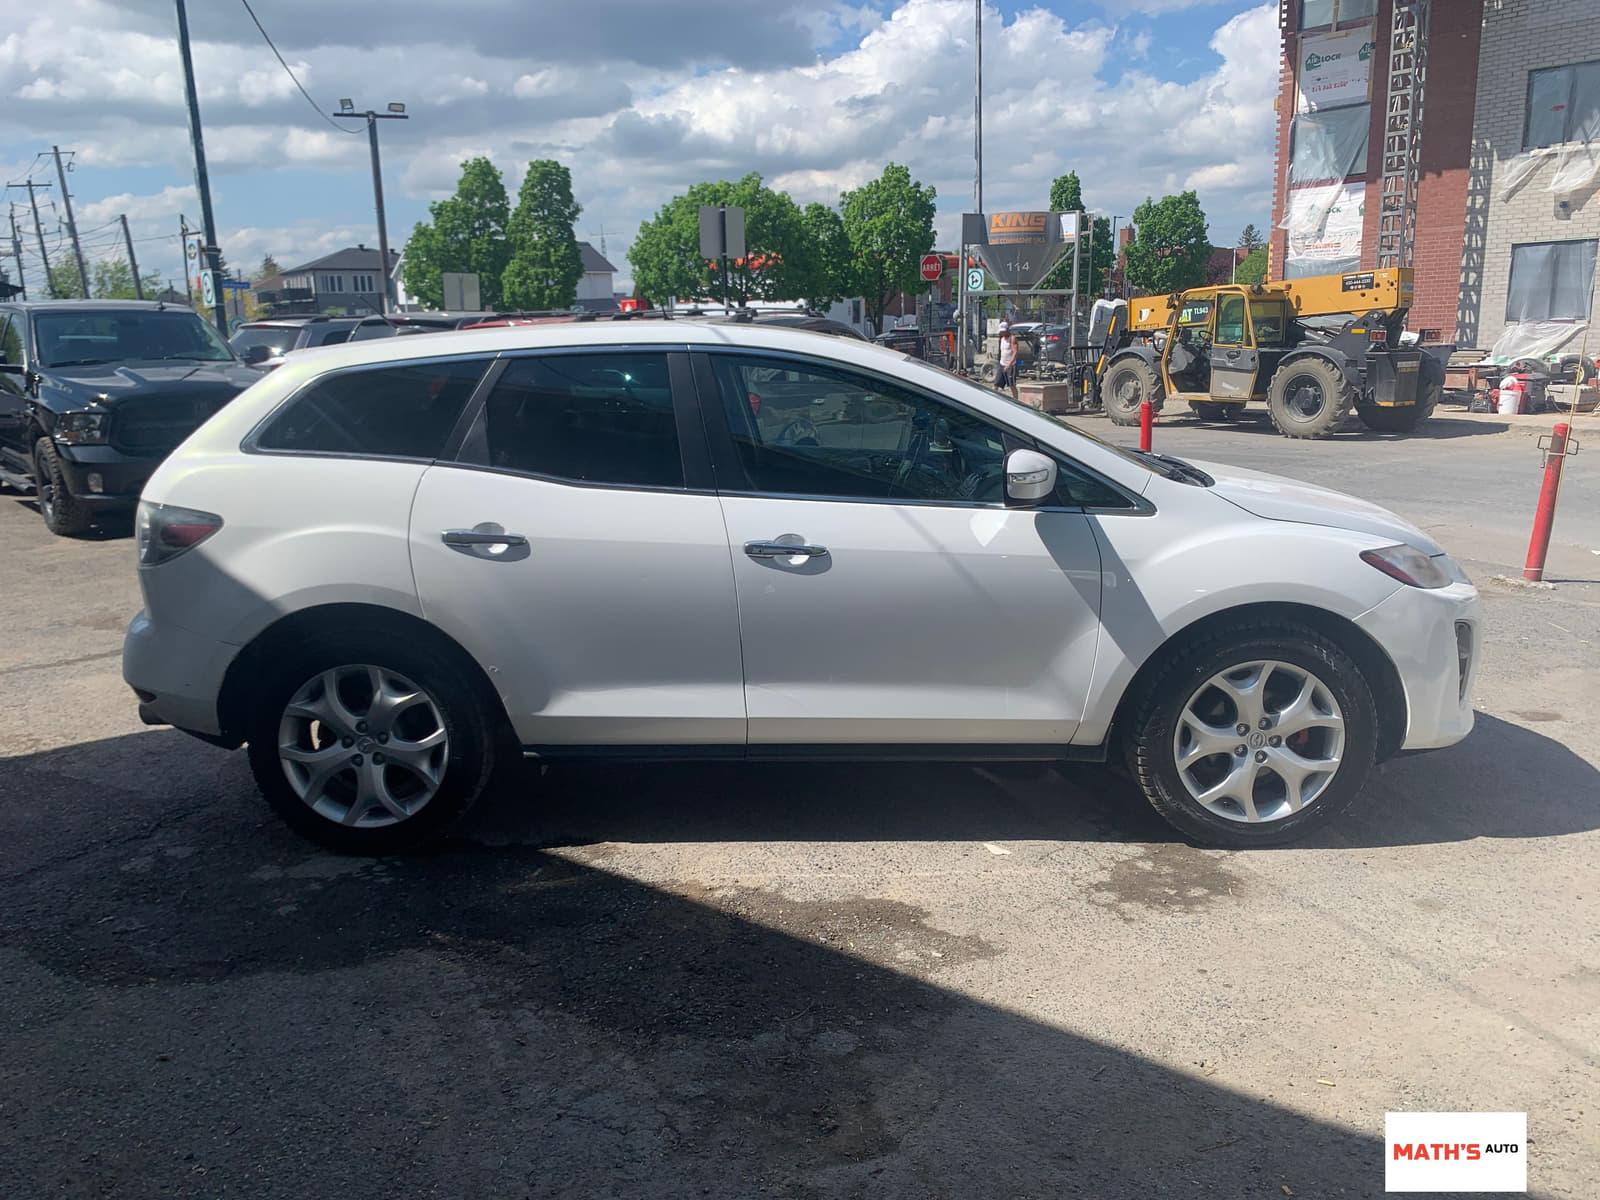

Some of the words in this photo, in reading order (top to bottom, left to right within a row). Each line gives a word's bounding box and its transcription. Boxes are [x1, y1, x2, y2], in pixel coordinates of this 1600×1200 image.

[991, 212, 1047, 226] KING
[922, 262, 941, 272] ARRÊT
[1006, 261, 1031, 272] 114
